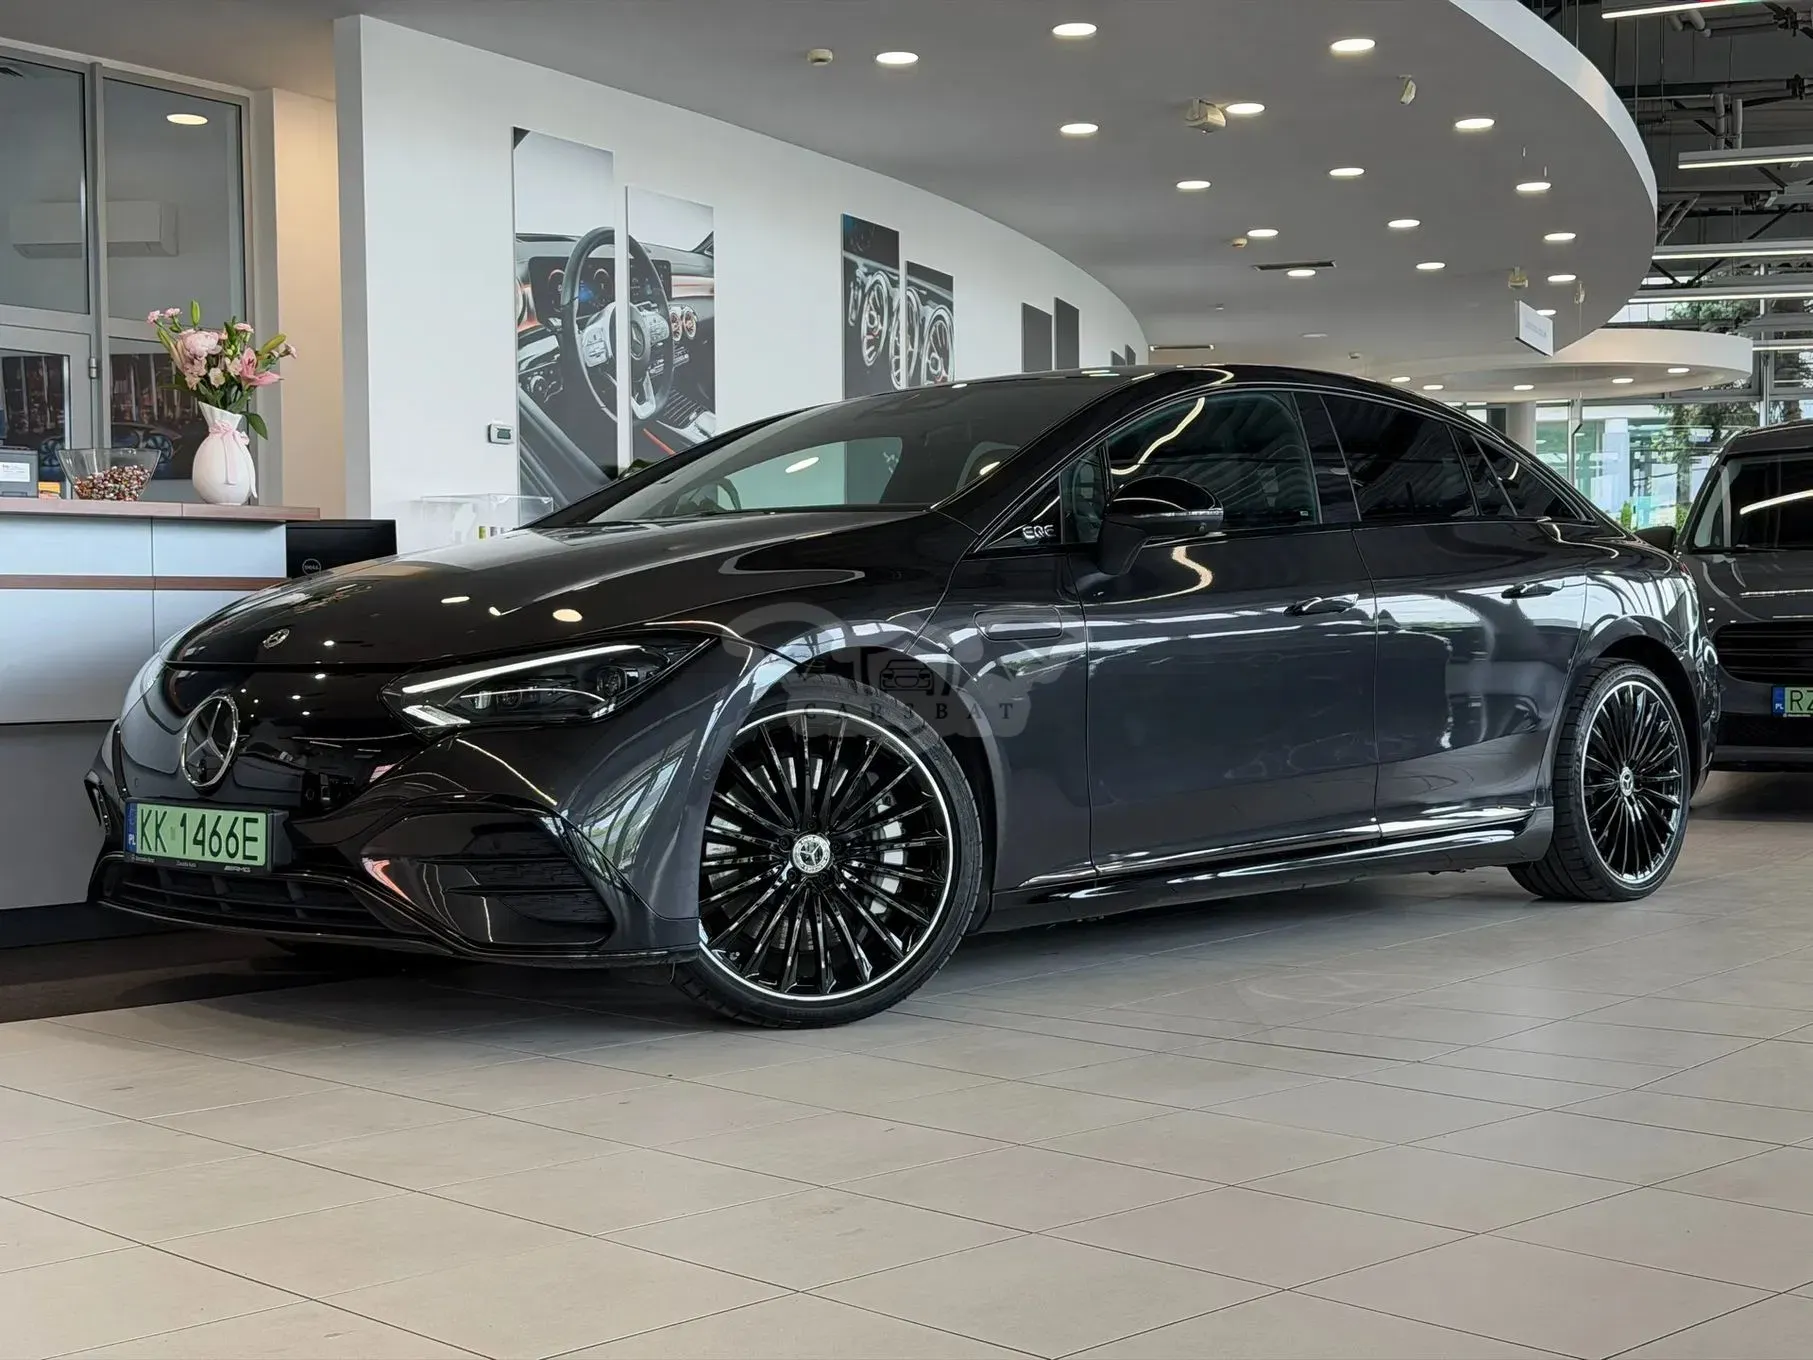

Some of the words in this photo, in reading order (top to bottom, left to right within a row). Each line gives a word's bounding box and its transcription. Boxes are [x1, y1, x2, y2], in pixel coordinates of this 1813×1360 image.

[1022, 524, 1056, 539] EQE
[128, 833, 137, 846] PL
[140, 808, 167, 853] KK
[180, 812, 259, 861] 1466E
